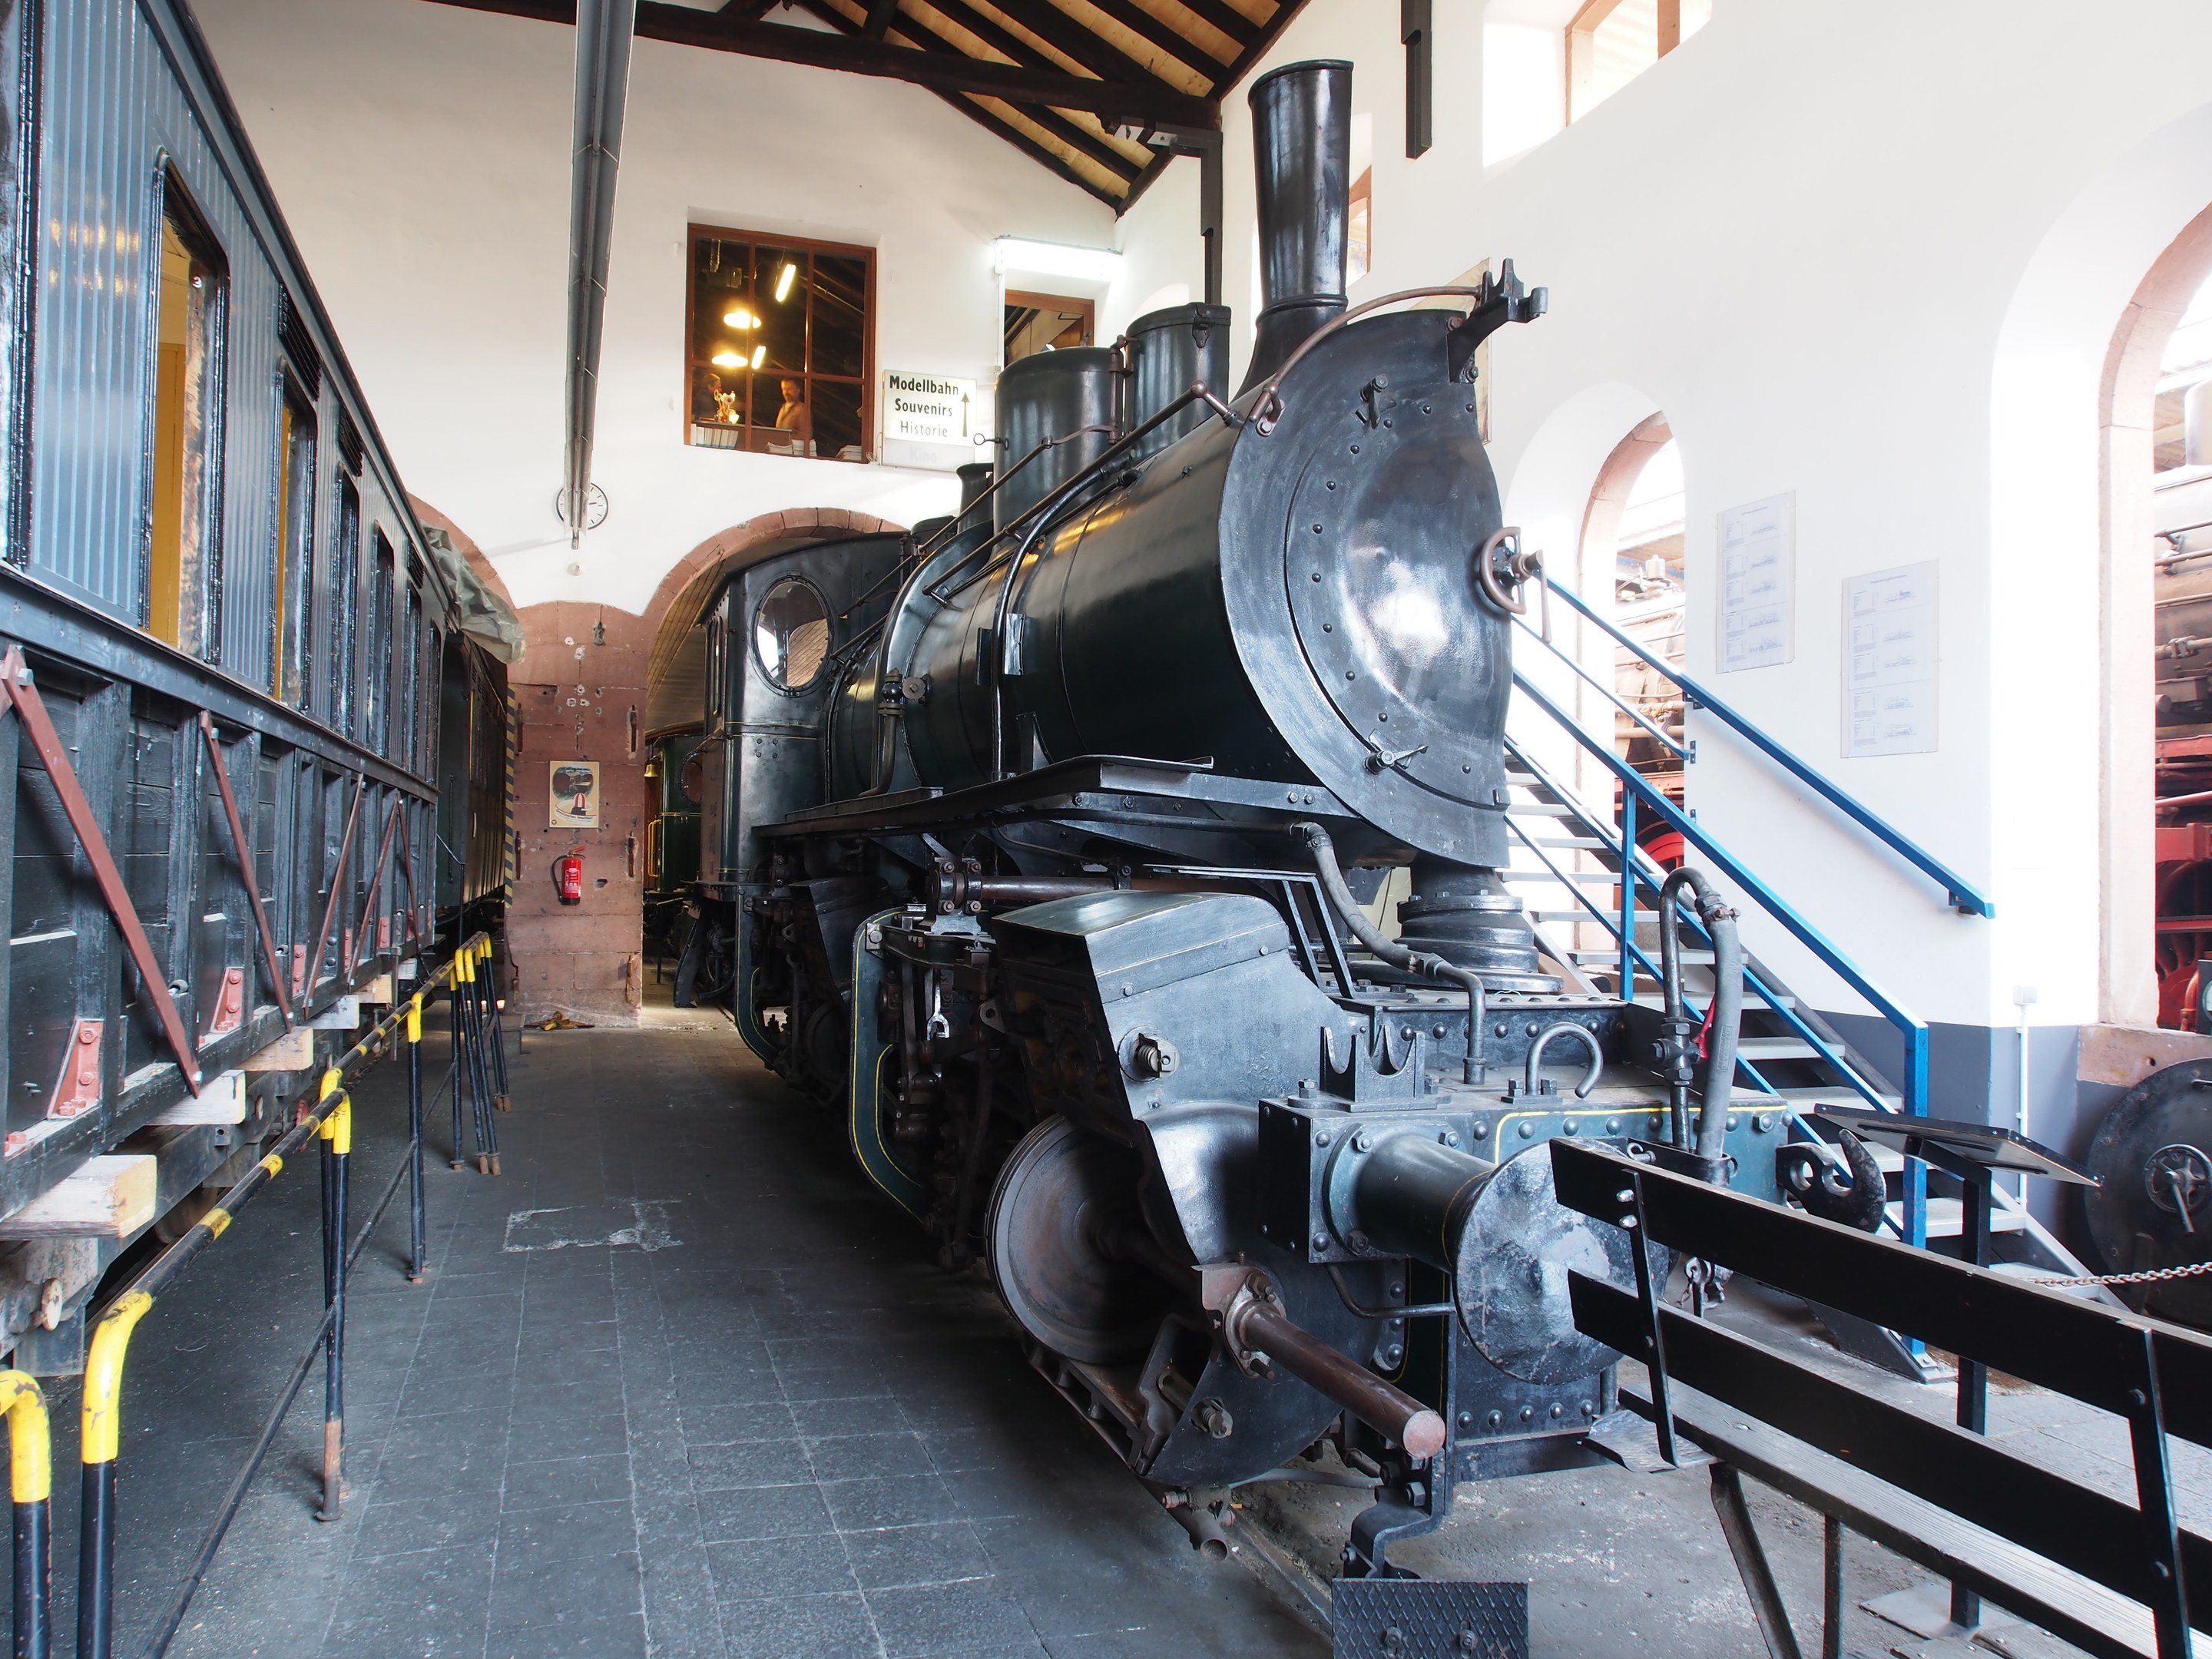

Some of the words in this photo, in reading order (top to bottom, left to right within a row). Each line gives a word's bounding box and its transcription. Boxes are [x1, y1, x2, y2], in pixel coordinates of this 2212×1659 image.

[889, 375, 959, 396] Modellbahn
[895, 398, 952, 416] Souvenirs
[900, 420, 948, 438] Historie
[909, 445, 938, 463] Kino
